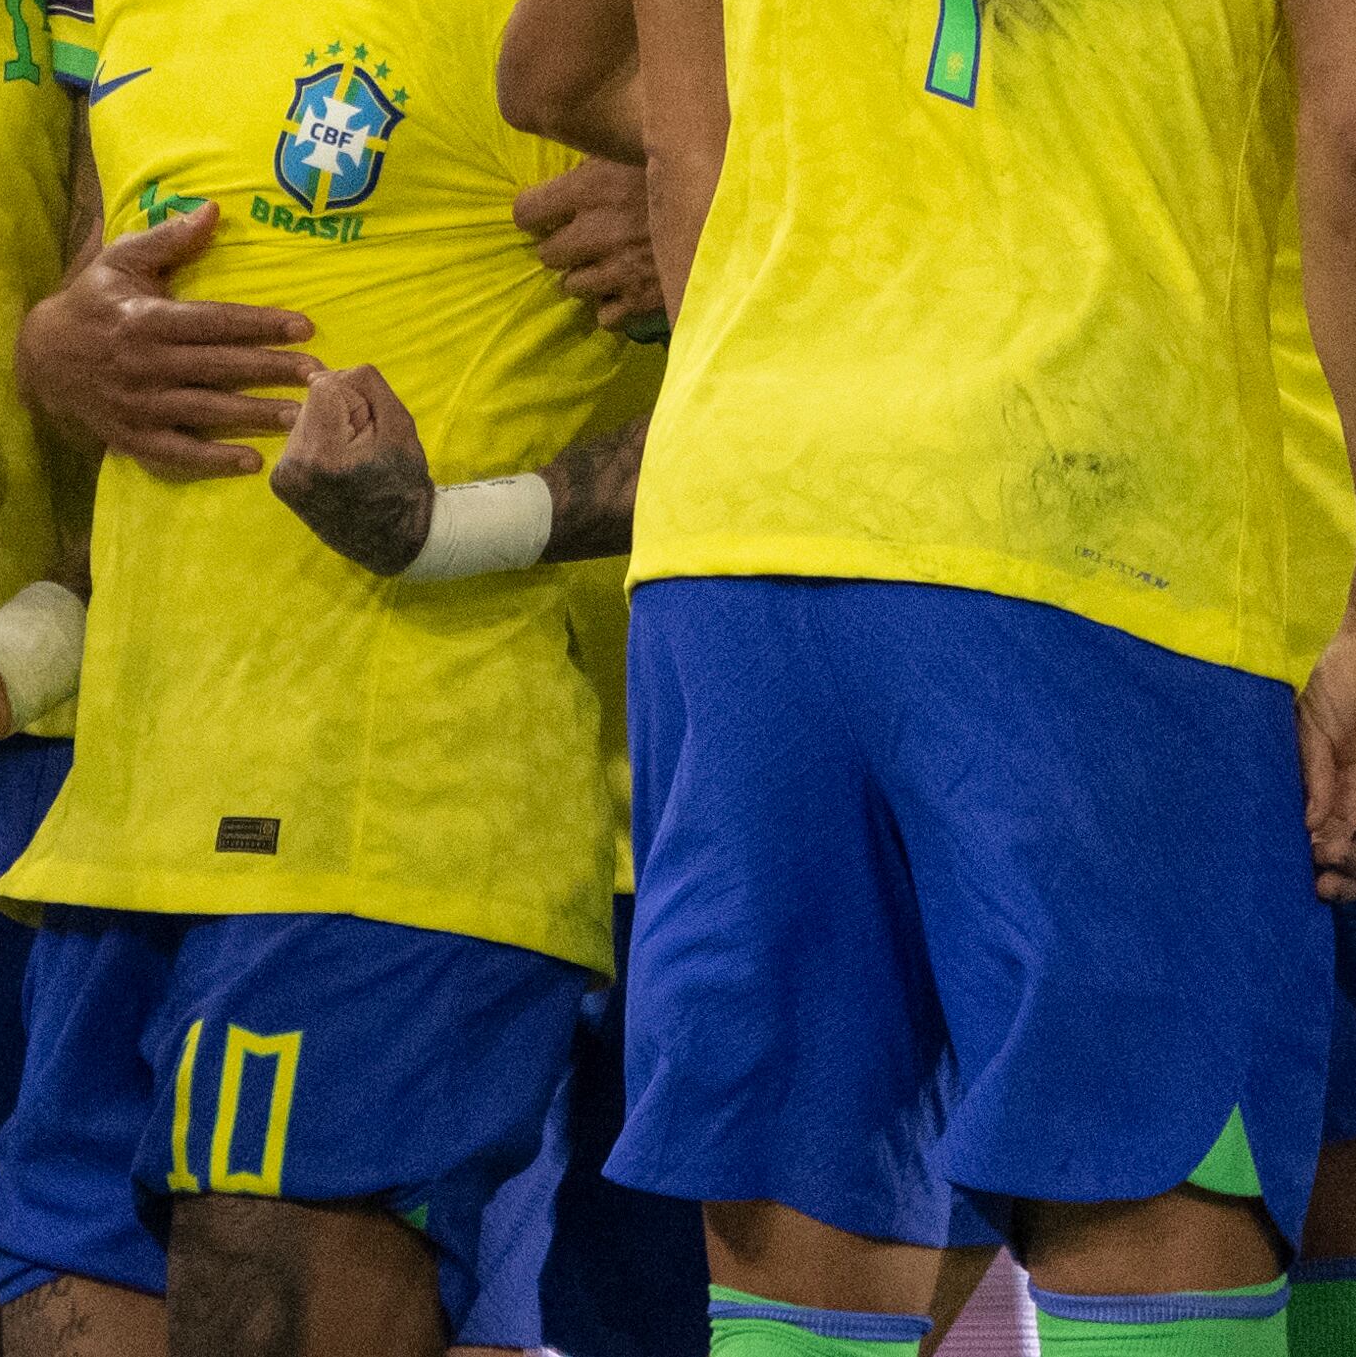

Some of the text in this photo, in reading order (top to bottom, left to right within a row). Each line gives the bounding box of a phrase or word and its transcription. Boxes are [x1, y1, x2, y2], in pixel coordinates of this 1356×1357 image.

[309, 122, 354, 148] CBF
[250, 195, 364, 244] BRASIL
[166, 1018, 304, 1198] 10
